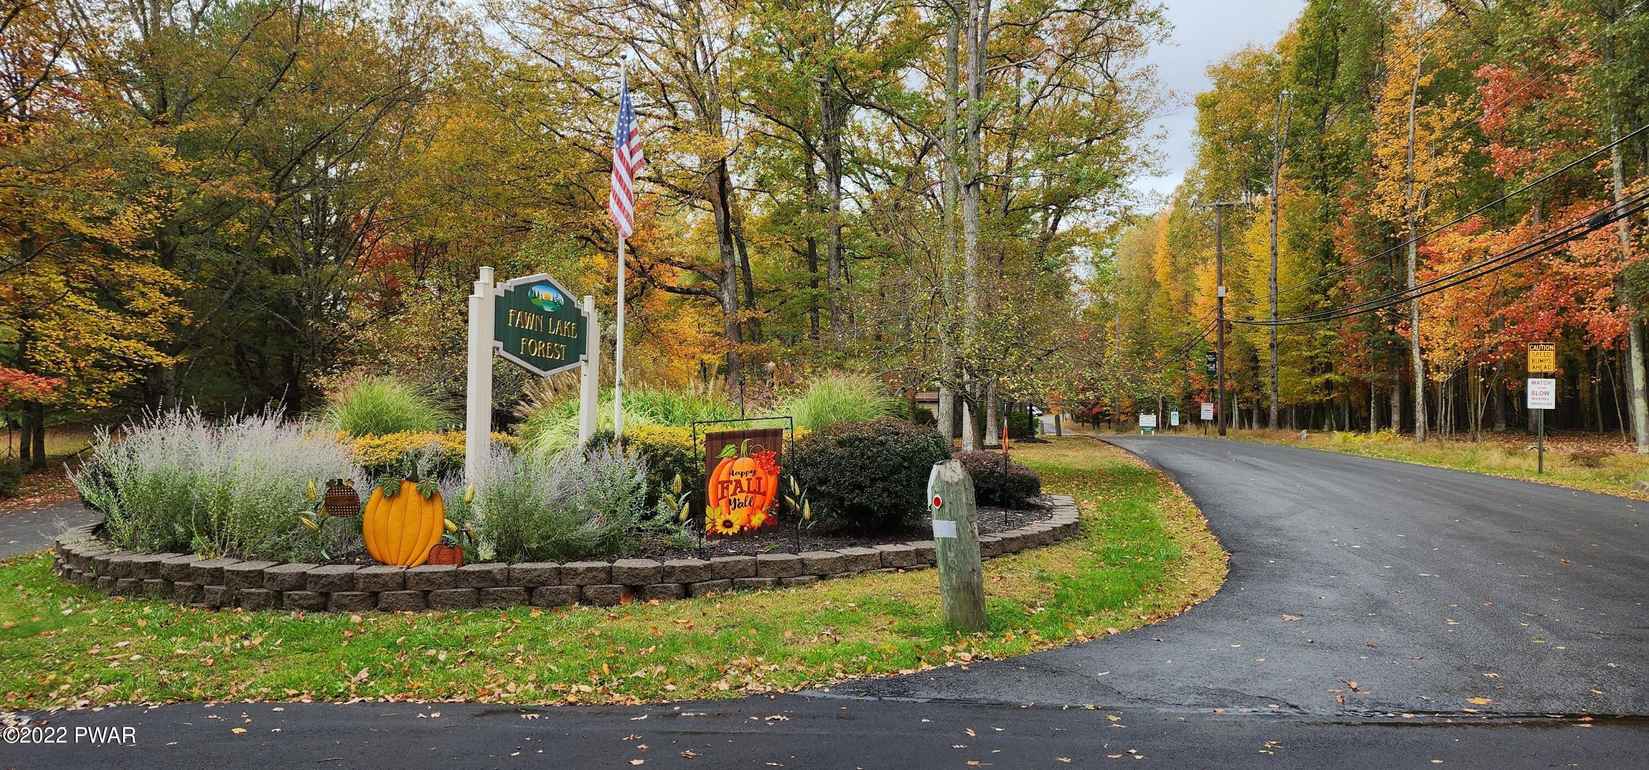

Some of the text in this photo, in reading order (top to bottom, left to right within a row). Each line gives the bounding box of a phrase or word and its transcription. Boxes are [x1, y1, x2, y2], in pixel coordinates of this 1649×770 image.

[508, 309, 578, 339] FAWN LAKE
[520, 337, 567, 360] FOREST
[730, 469, 756, 479] Happy
[718, 476, 767, 501] FALL
